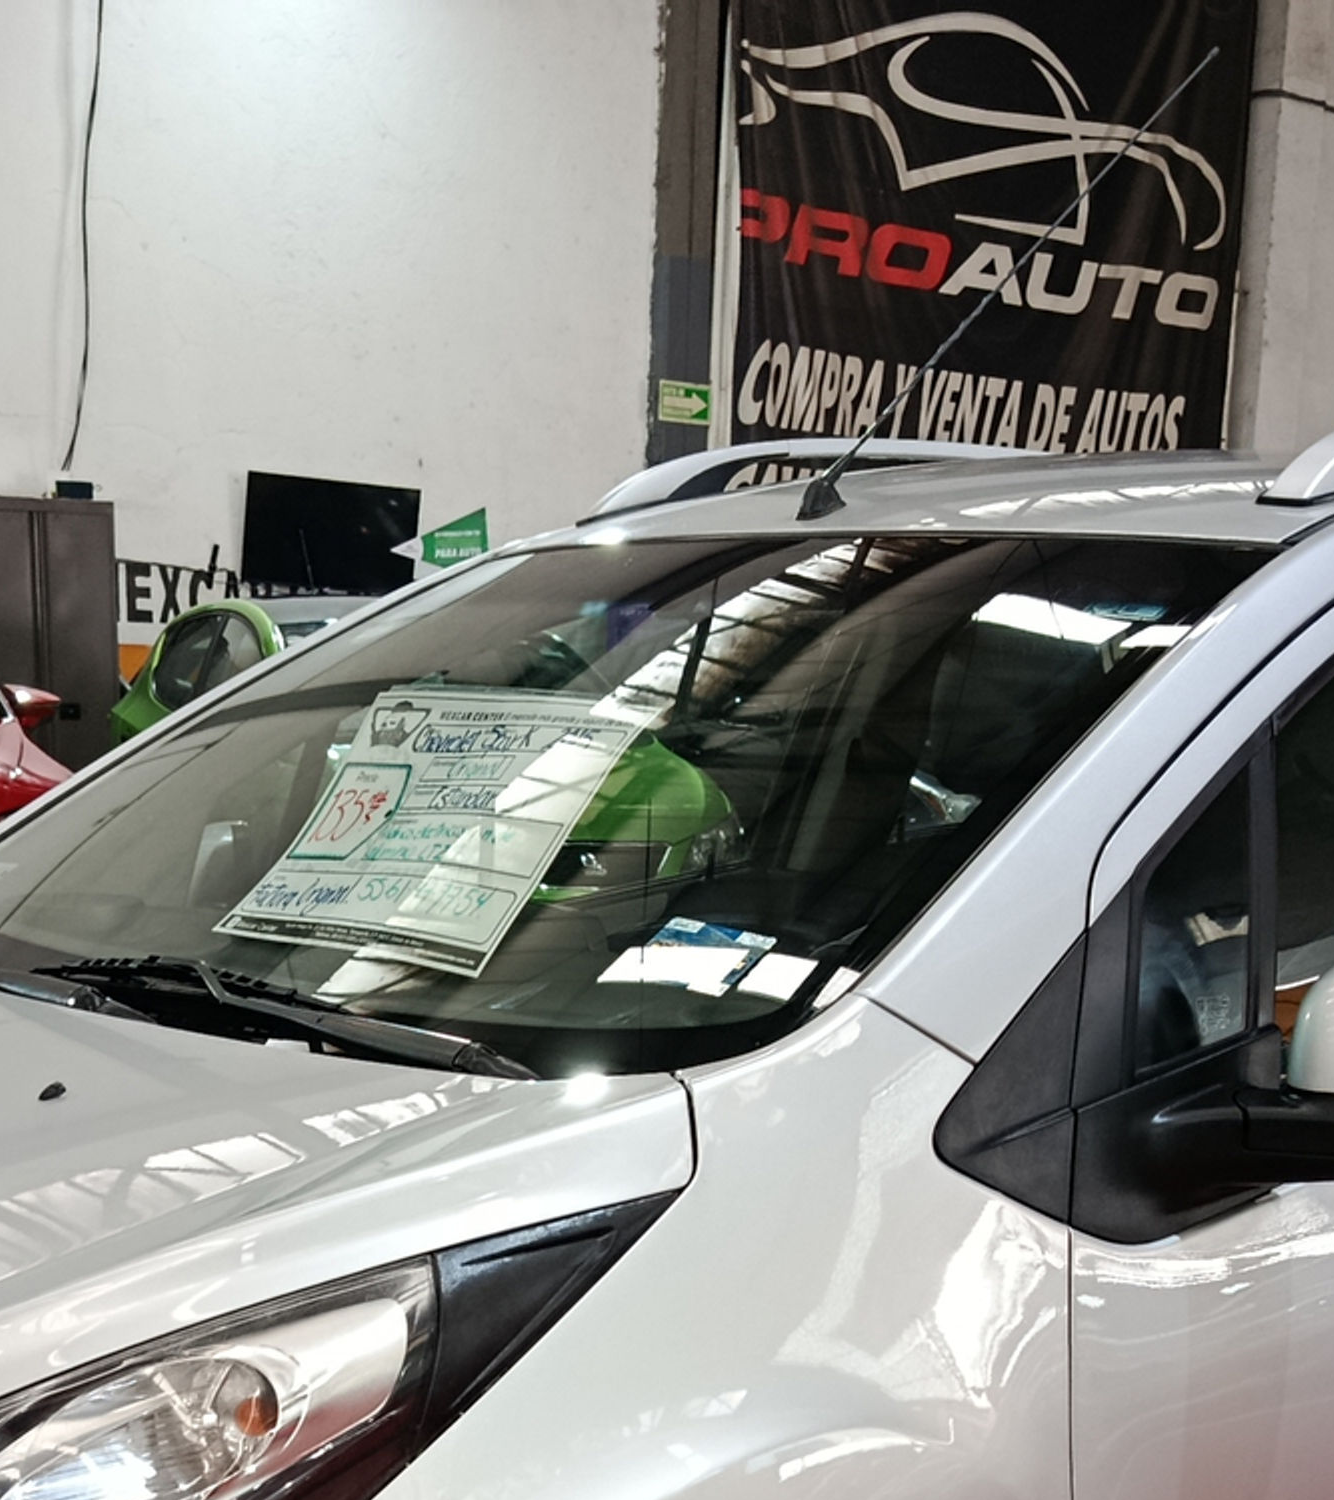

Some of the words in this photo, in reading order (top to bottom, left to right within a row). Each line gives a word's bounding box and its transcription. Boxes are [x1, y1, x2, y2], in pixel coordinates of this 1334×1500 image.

[738, 339, 885, 437] COMPRA
[890, 364, 923, 440] Y
[917, 368, 1024, 448] VENTA
[1025, 383, 1078, 453] DE
[1076, 388, 1186, 453] AUTOS
[473, 711, 504, 721] CENTER
[309, 788, 369, 842] 135
